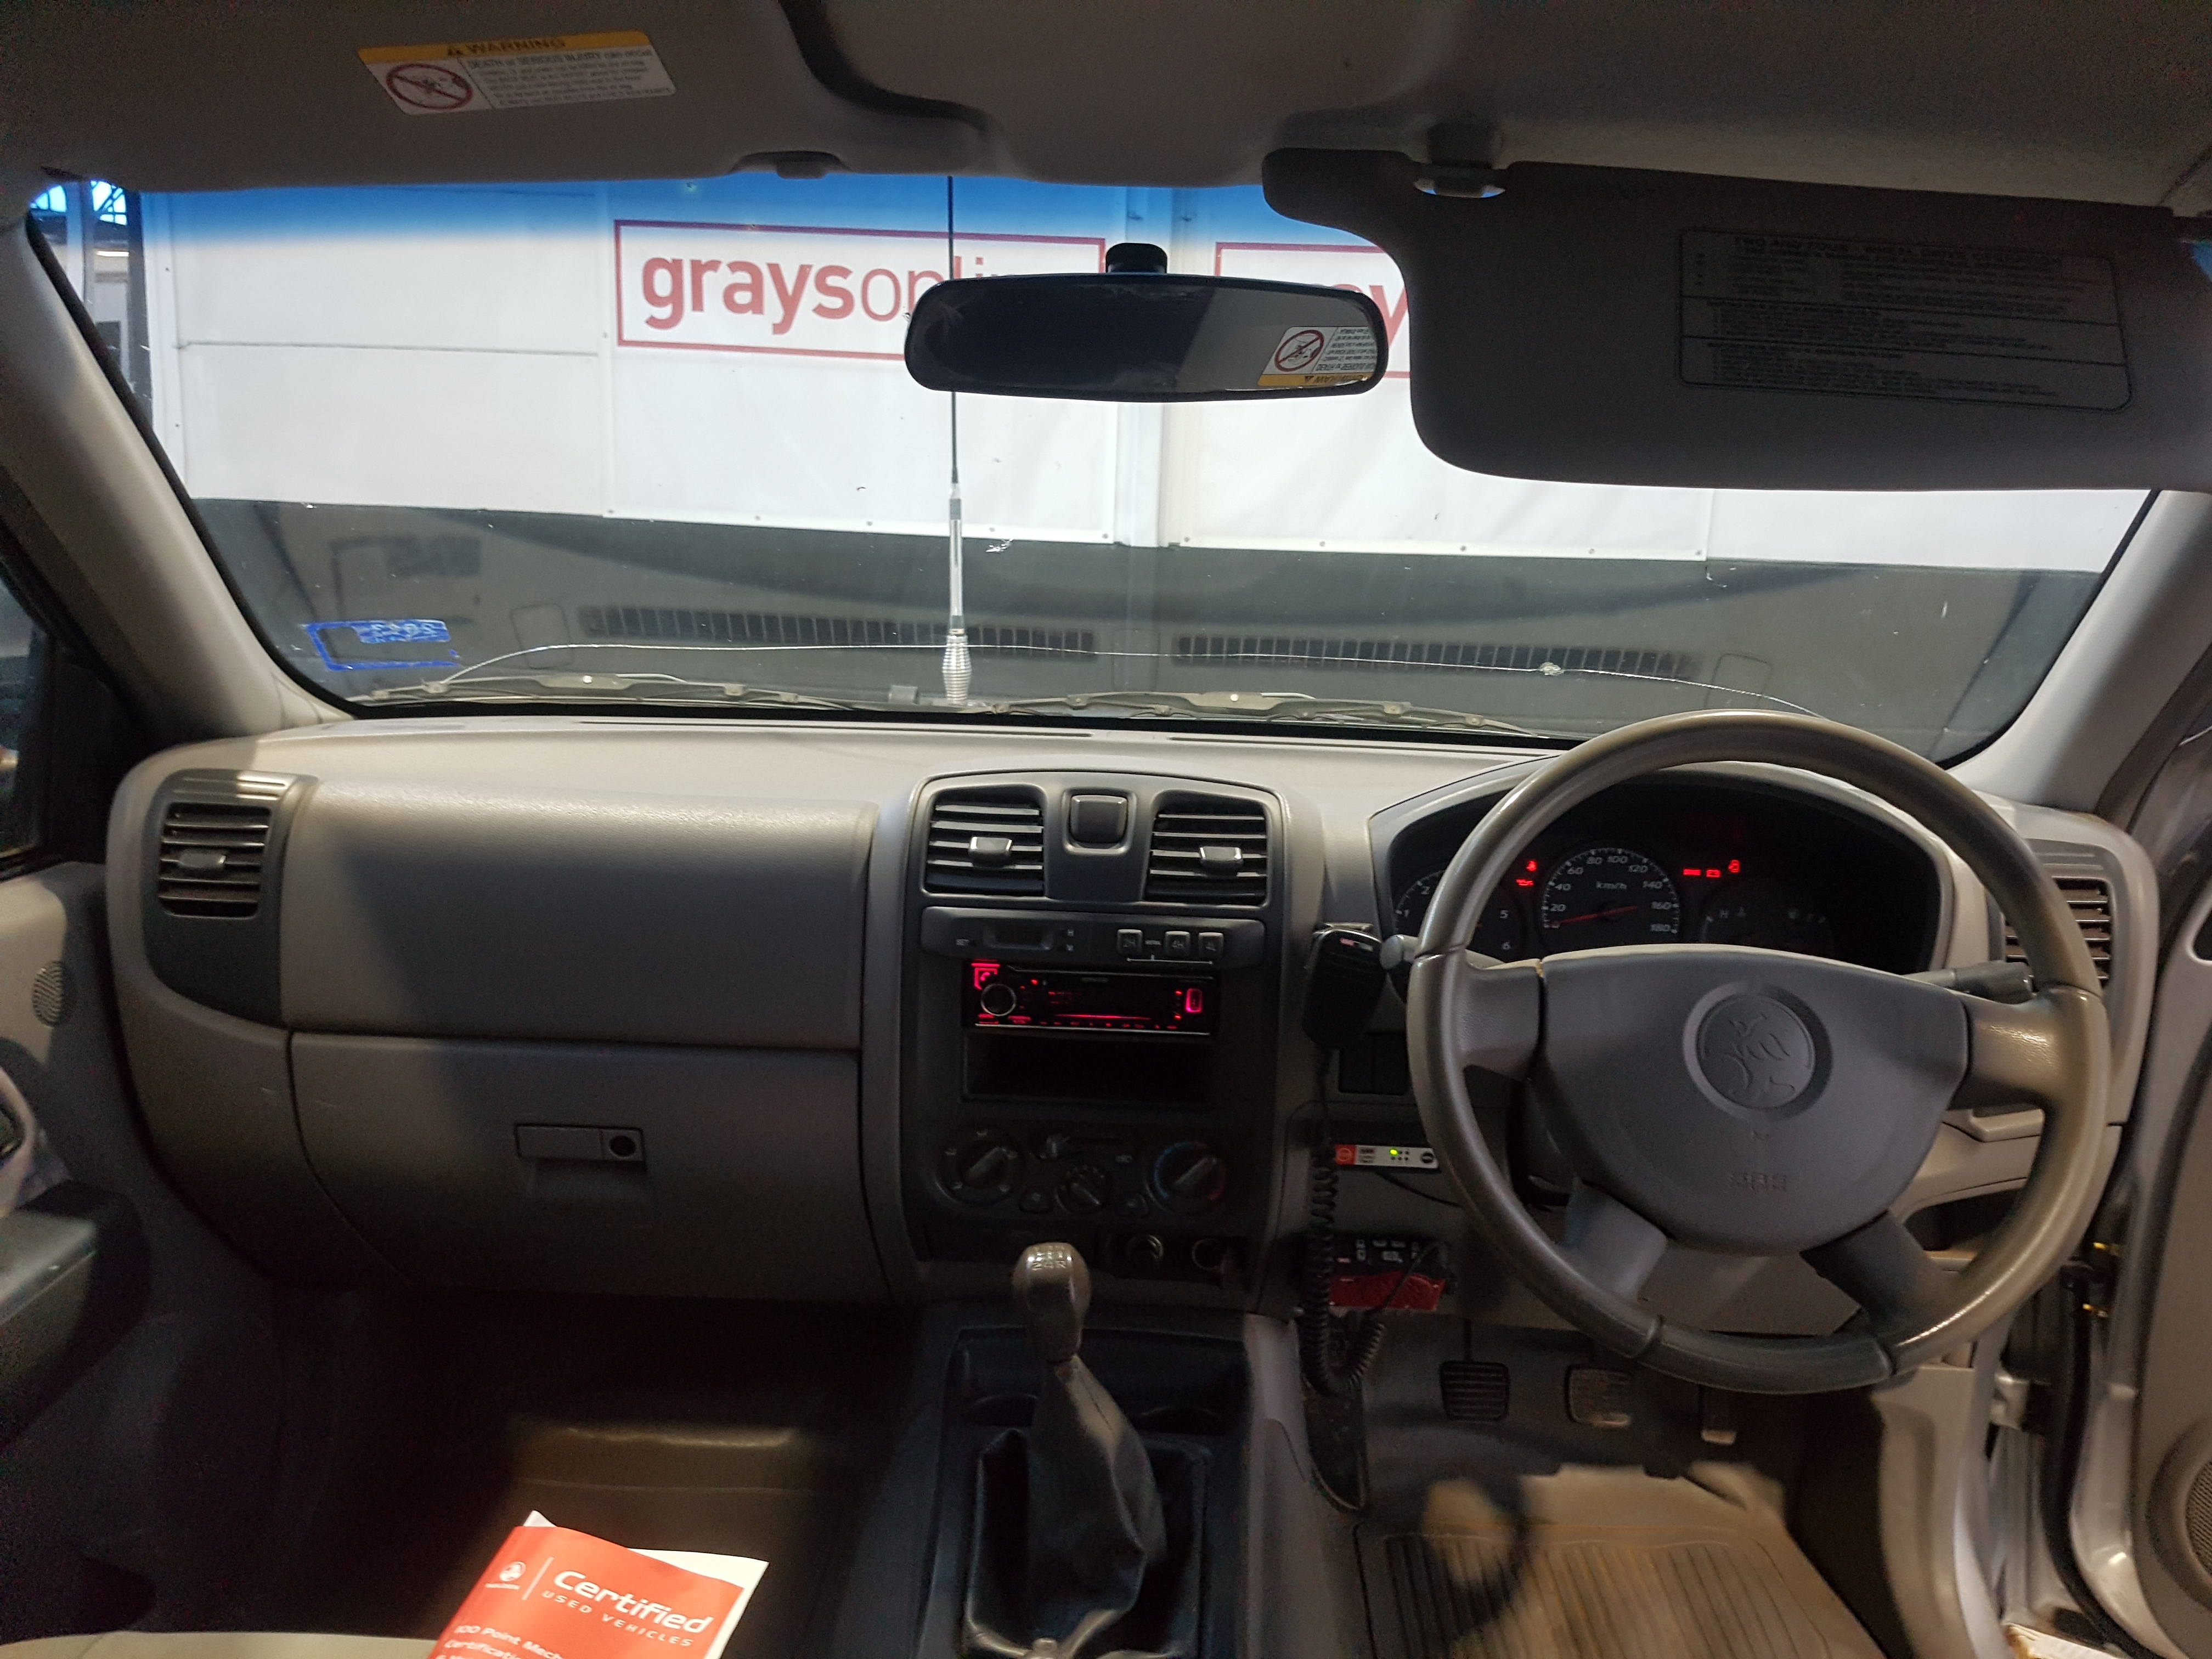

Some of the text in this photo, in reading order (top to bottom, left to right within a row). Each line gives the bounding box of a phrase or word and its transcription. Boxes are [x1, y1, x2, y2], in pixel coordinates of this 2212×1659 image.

[465, 38, 566, 57] WARNING
[642, 256, 1009, 336] grayson
[1607, 855, 1628, 864] 100
[1567, 866, 1584, 874] 60
[1420, 885, 1431, 895] 2
[1555, 880, 1663, 891] 40 140
[1595, 881, 1628, 890] km/h
[1550, 903, 1566, 912] 20
[1499, 909, 1510, 919] 5
[1501, 941, 1511, 951] 6
[554, 1571, 714, 1633] Certified
[541, 1590, 694, 1647] USED VEHICLES
[481, 1627, 521, 1645] Point
